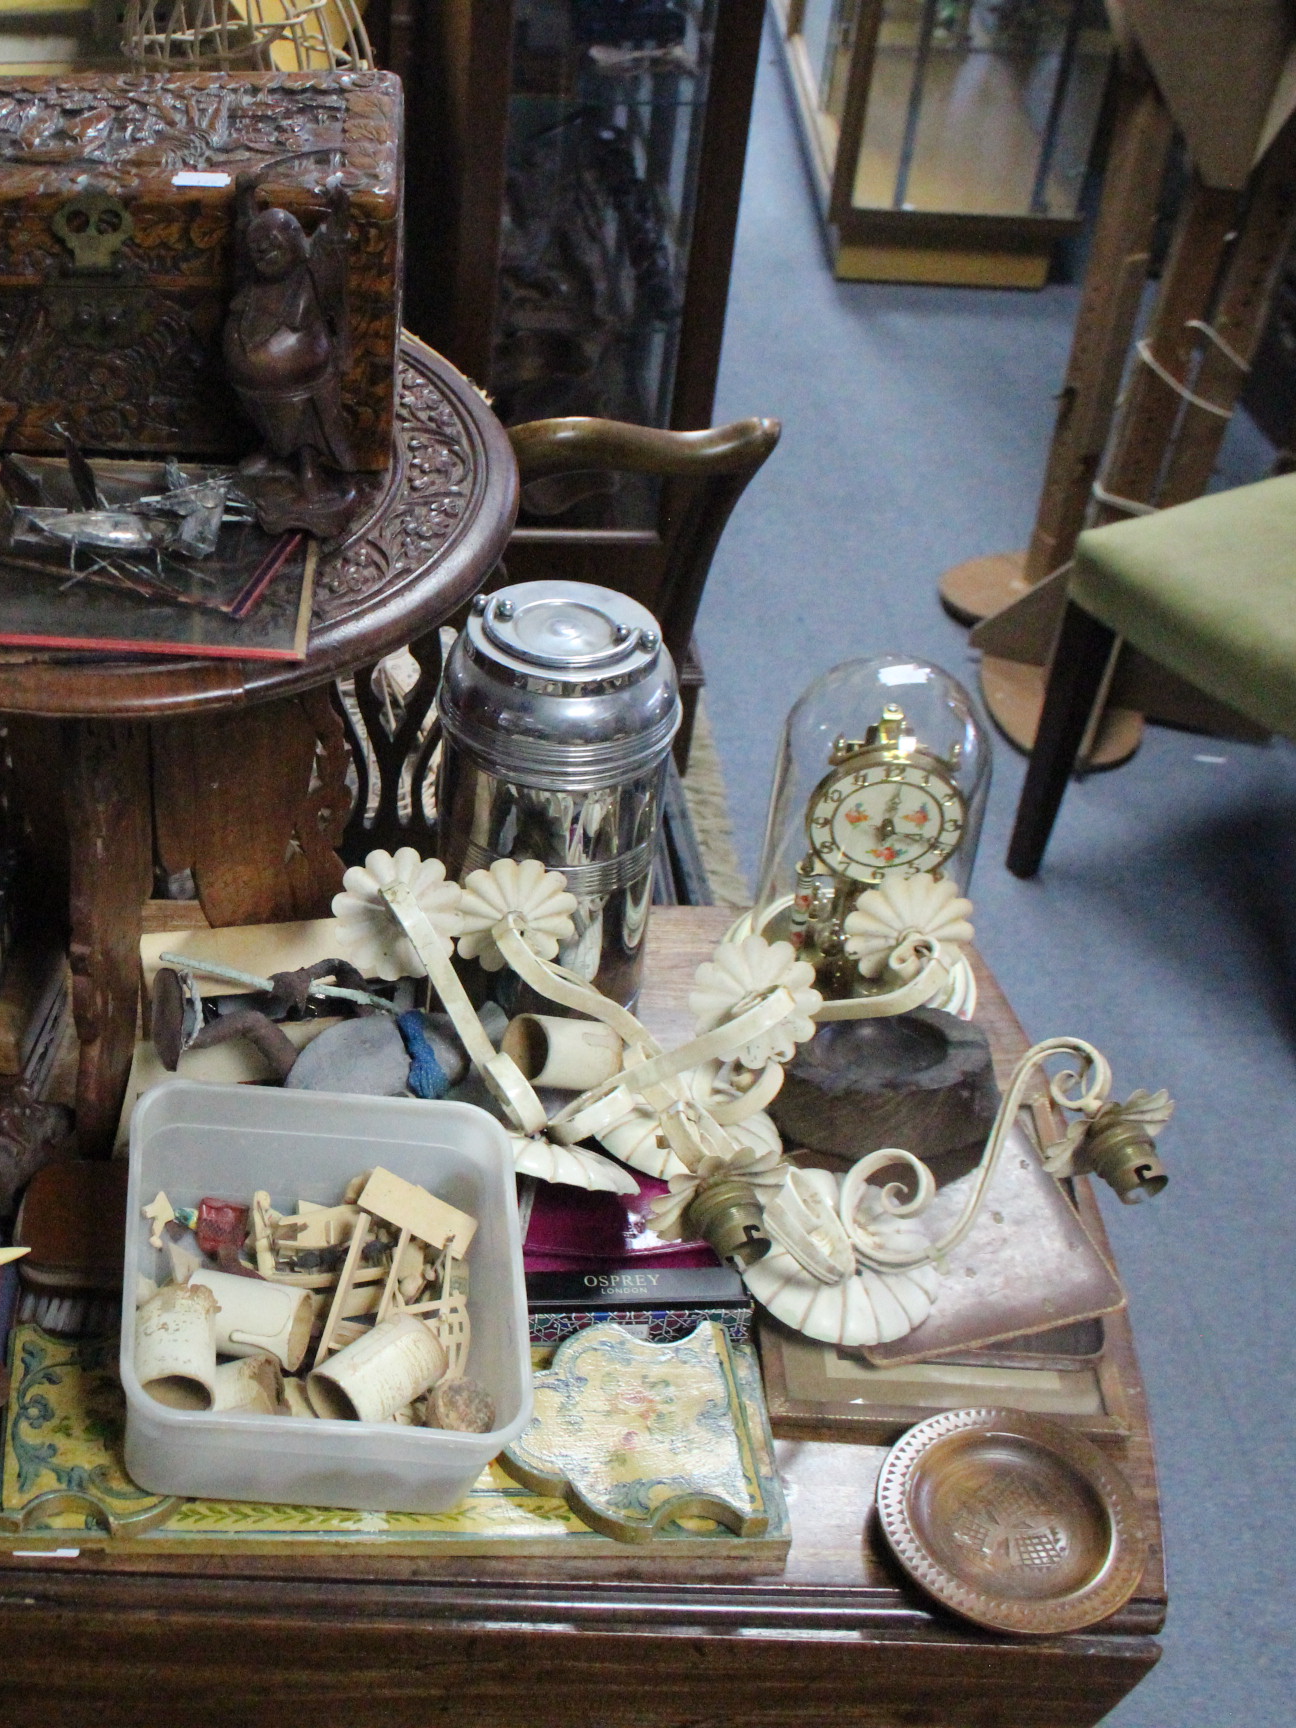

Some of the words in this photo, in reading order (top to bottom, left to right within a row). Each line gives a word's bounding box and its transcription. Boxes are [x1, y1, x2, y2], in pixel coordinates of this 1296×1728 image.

[823, 789, 843, 804] 10
[583, 1273, 660, 1287] OSPREY
[601, 1287, 648, 1295] LONDON
